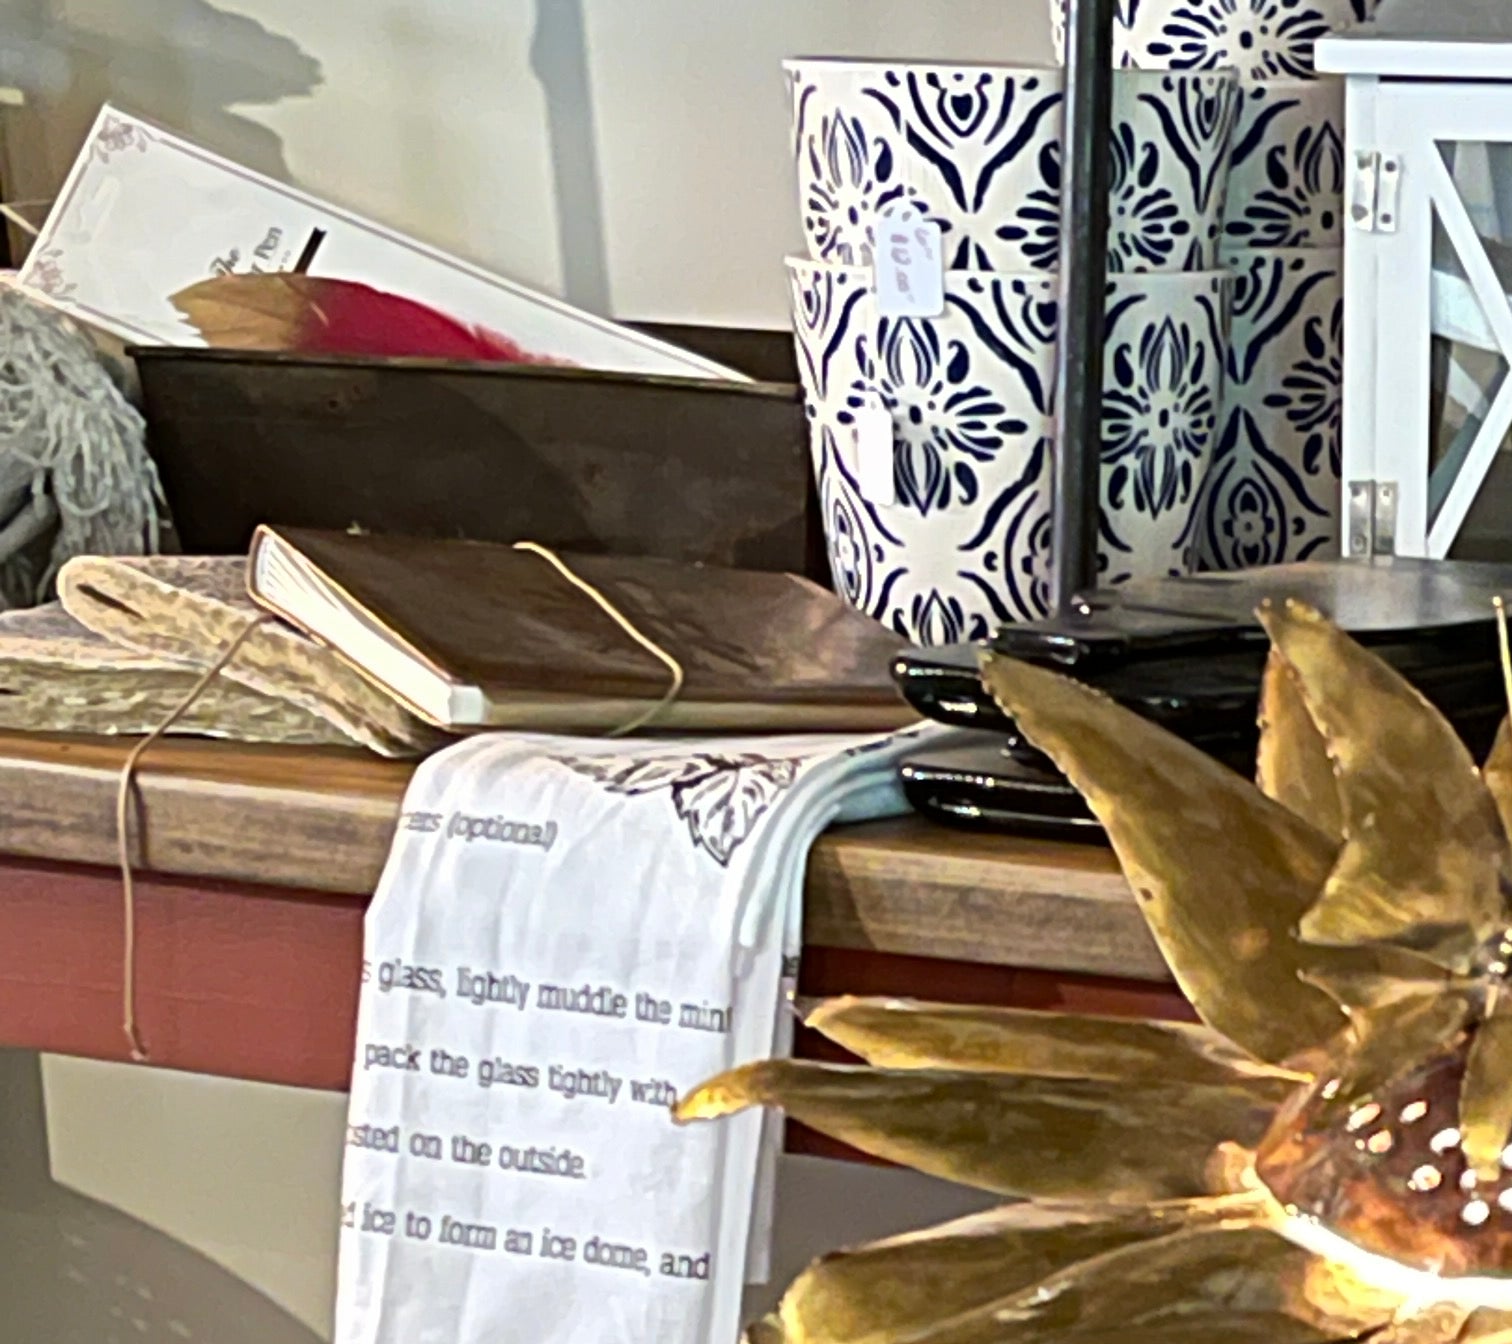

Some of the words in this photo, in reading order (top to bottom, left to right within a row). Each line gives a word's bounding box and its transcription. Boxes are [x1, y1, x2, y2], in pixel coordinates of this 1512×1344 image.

[378, 957, 447, 999] glass,
[456, 965, 531, 1012] lightly
[536, 983, 629, 1019] muddle
[634, 990, 673, 1026] the
[363, 1042, 422, 1071] pack
[430, 1048, 470, 1079] the
[477, 1056, 541, 1088] glass
[547, 1063, 624, 1105] tightly
[629, 1077, 678, 1107] with
[409, 1131, 443, 1161] on
[451, 1134, 493, 1167] the
[360, 1201, 397, 1235] ice
[405, 1210, 432, 1240] to
[438, 1213, 498, 1251] form
[503, 1228, 533, 1256] an
[538, 1226, 577, 1262] ice
[582, 1235, 651, 1278] dome,
[659, 1251, 711, 1281] and
